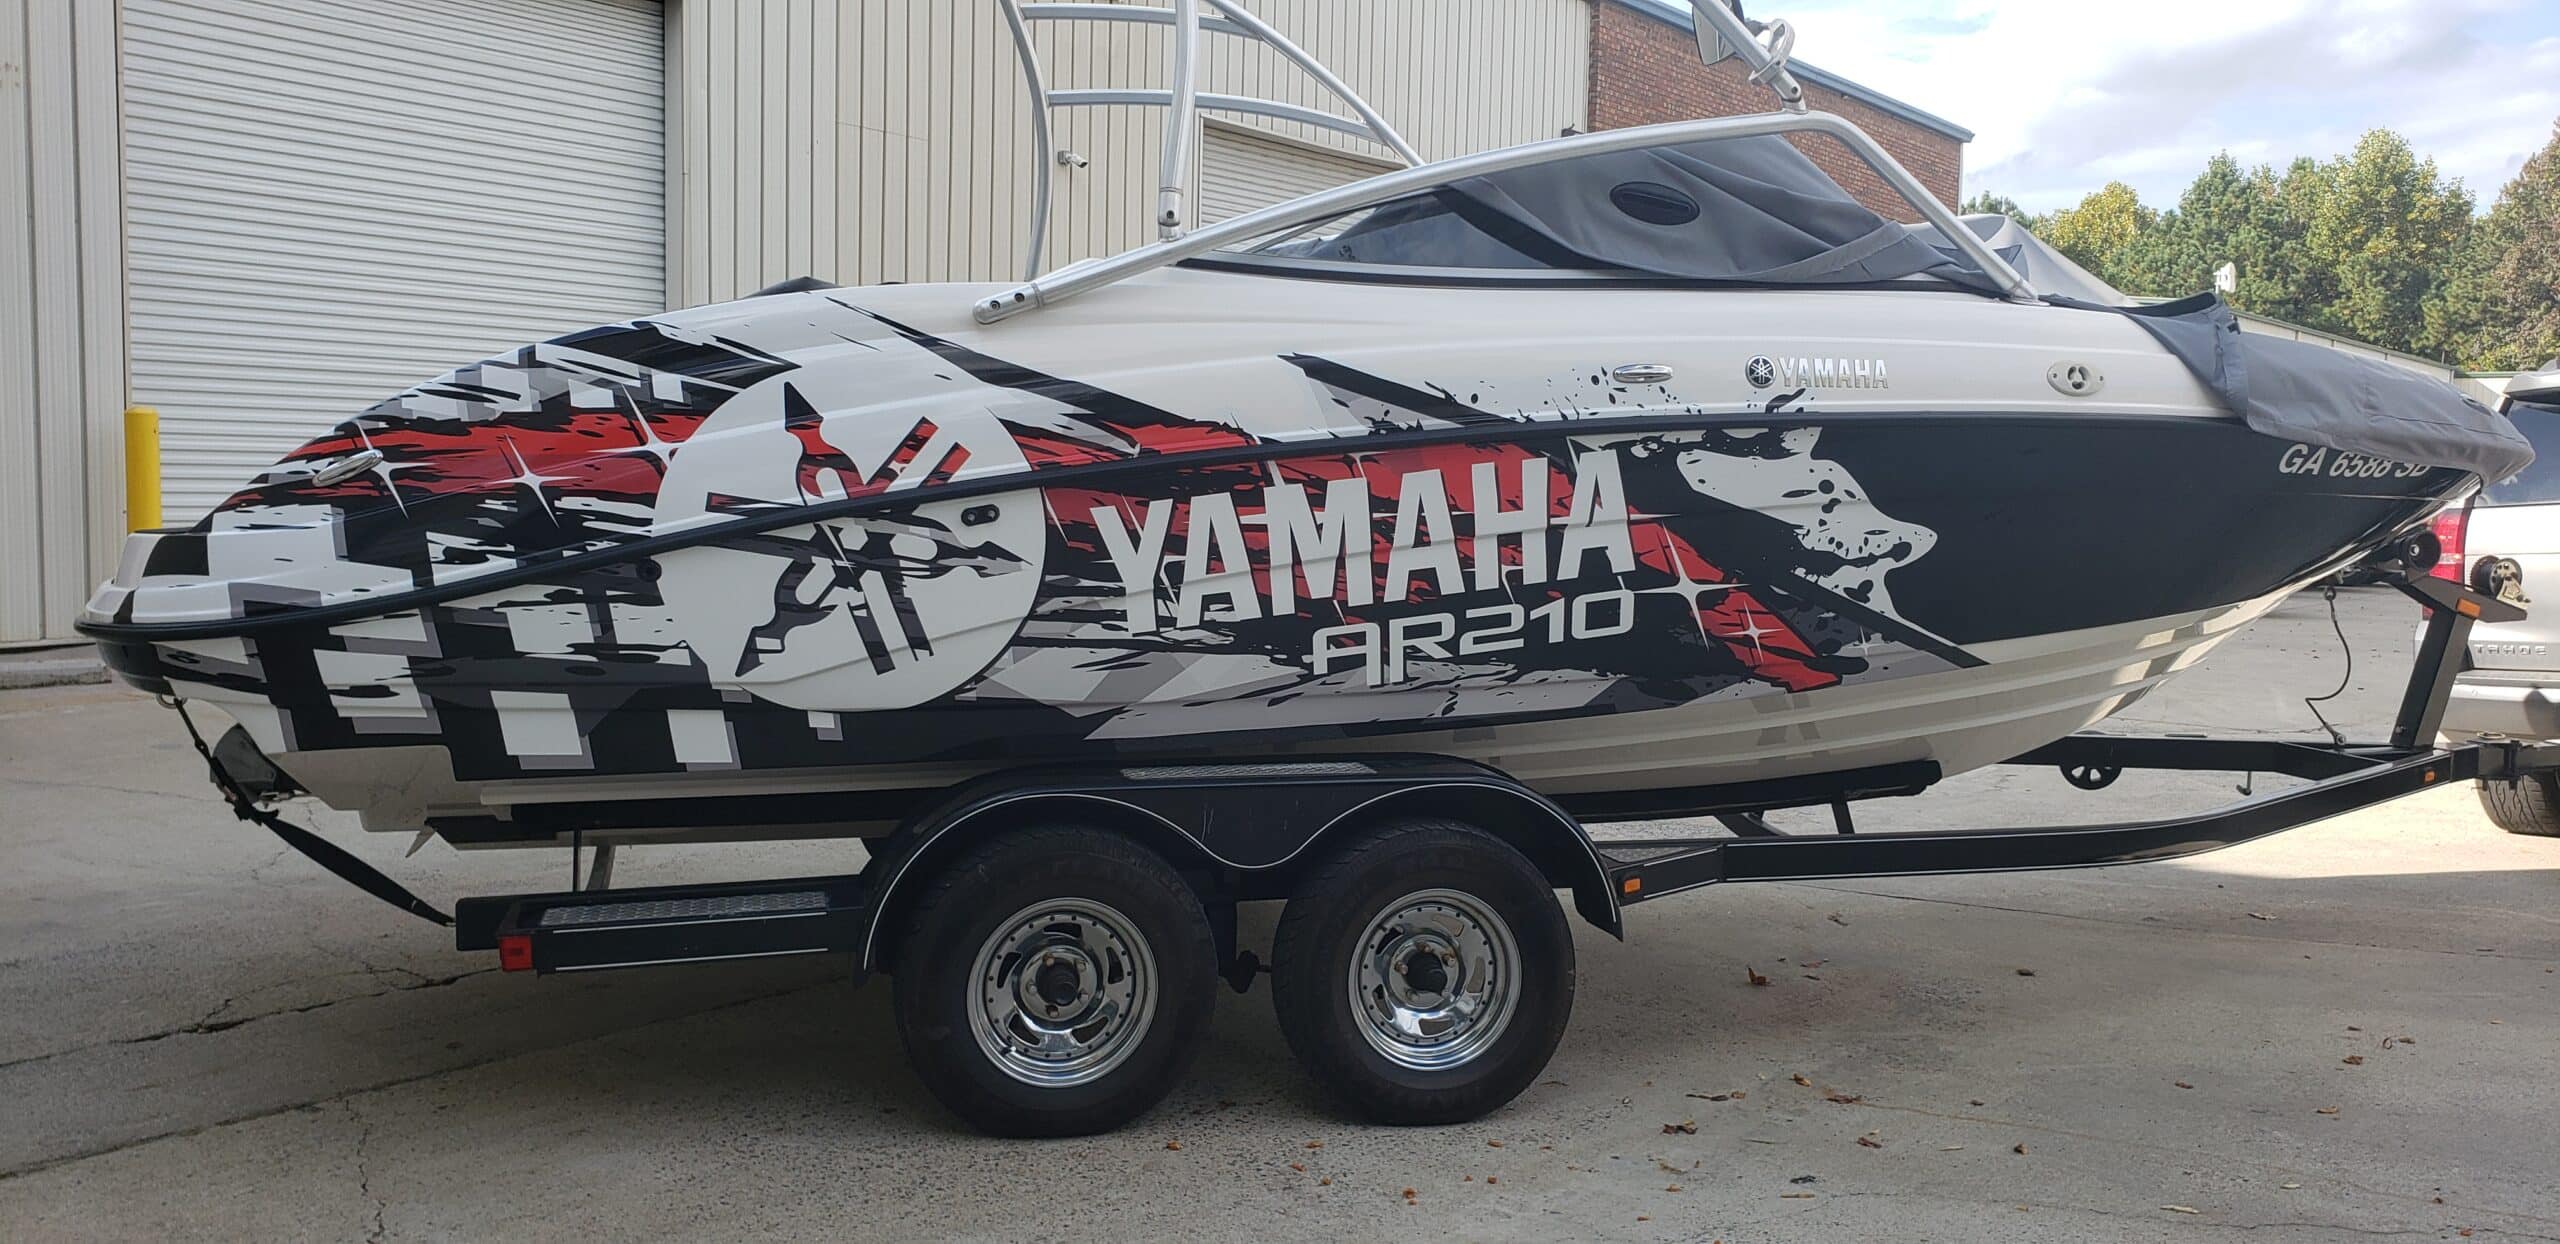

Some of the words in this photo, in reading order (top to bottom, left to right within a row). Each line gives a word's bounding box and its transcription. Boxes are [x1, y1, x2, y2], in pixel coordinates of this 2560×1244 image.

[1776, 355, 1888, 389] YAMAHA
[2279, 444, 2327, 475] GA
[2329, 452, 2393, 478] 6588
[1090, 448, 1637, 637] YAMAHA
[1312, 589, 1635, 687] AR210
[2473, 644, 2548, 656] TAHOE
